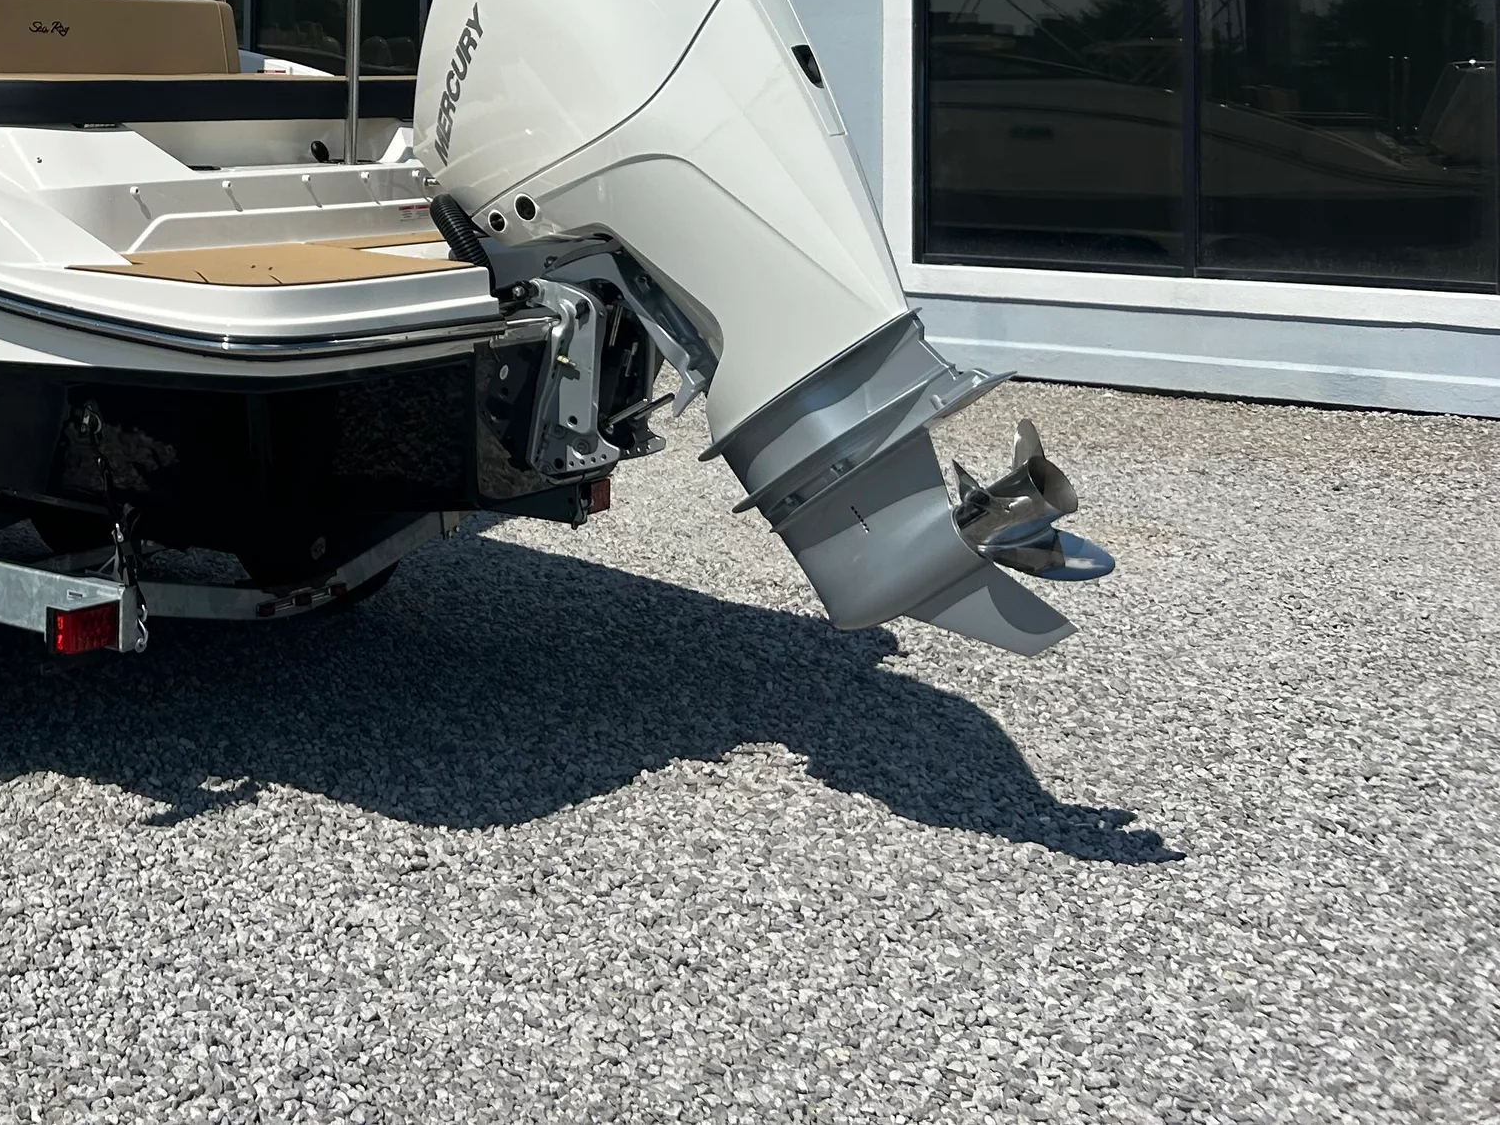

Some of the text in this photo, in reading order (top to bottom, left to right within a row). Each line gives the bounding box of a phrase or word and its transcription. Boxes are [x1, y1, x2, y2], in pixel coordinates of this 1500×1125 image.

[28, 21, 70, 37] Sea Ray
[434, 2, 484, 167] MERCURY
